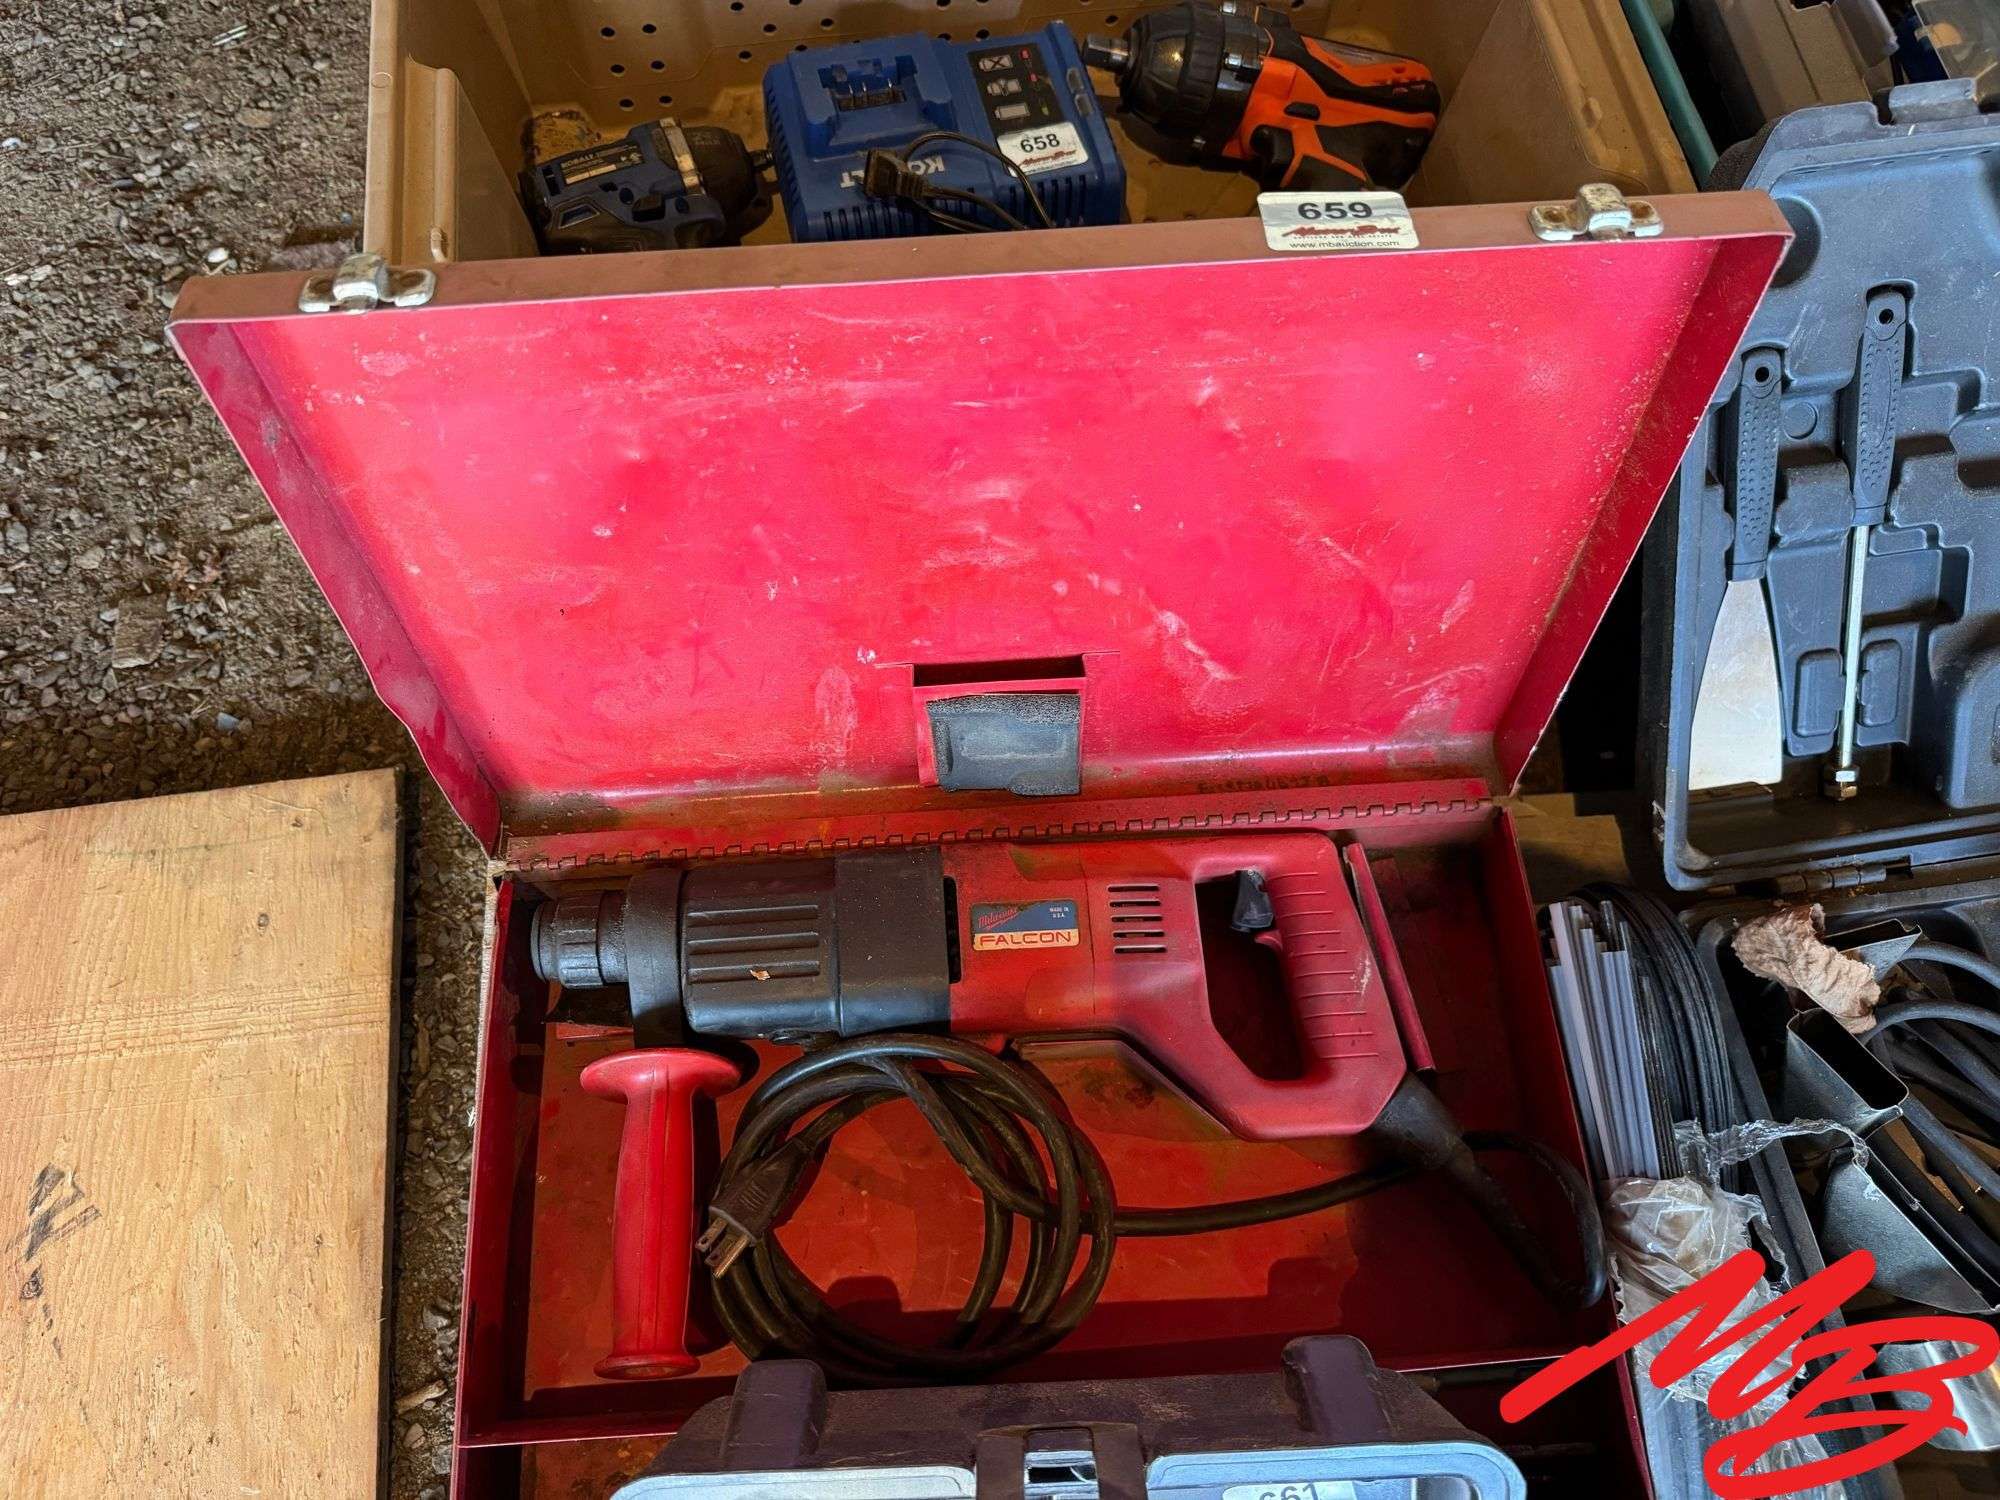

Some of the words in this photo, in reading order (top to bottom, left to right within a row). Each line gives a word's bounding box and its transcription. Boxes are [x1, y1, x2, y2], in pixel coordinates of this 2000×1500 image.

[1020, 133, 1061, 153] 658
[840, 155, 945, 188] KOLT
[1297, 202, 1373, 220] 659
[1289, 239, 1400, 249] www.mbauction.com
[980, 931, 1072, 946] FALCON
